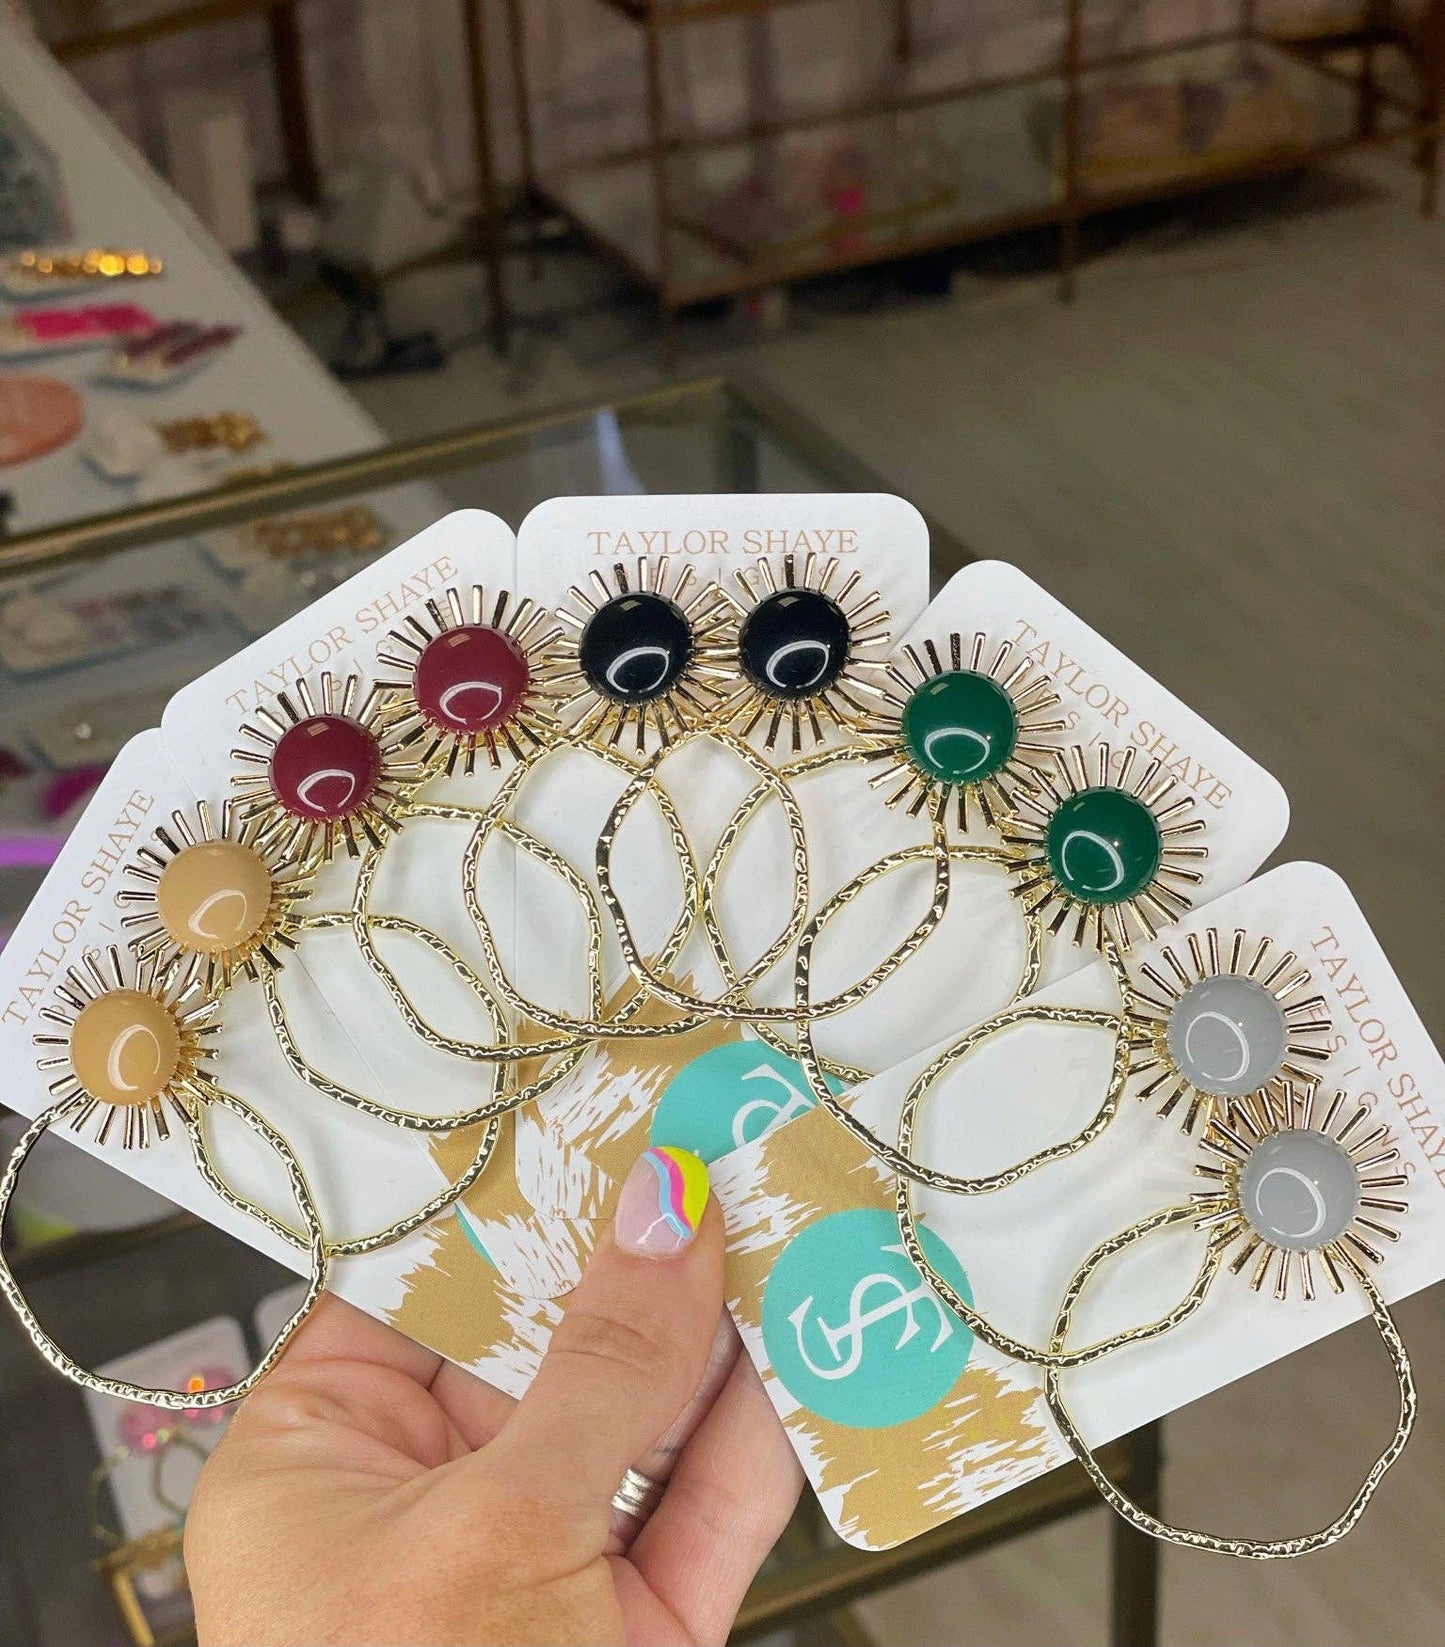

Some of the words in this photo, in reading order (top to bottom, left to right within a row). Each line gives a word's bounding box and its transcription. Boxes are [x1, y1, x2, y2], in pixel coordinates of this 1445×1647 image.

[587, 529, 731, 556] TAYLOR
[743, 529, 859, 555] SHAYE
[225, 625, 354, 715] TAYLOR
[355, 556, 458, 634] SHAYE
[1009, 618, 1130, 728] TAYLOR
[1130, 720, 1233, 810] SHAYE
[1, 898, 92, 1026] TAYLOR
[80, 789, 155, 896] SHAYE
[1310, 926, 1399, 1071] TAYLOR
